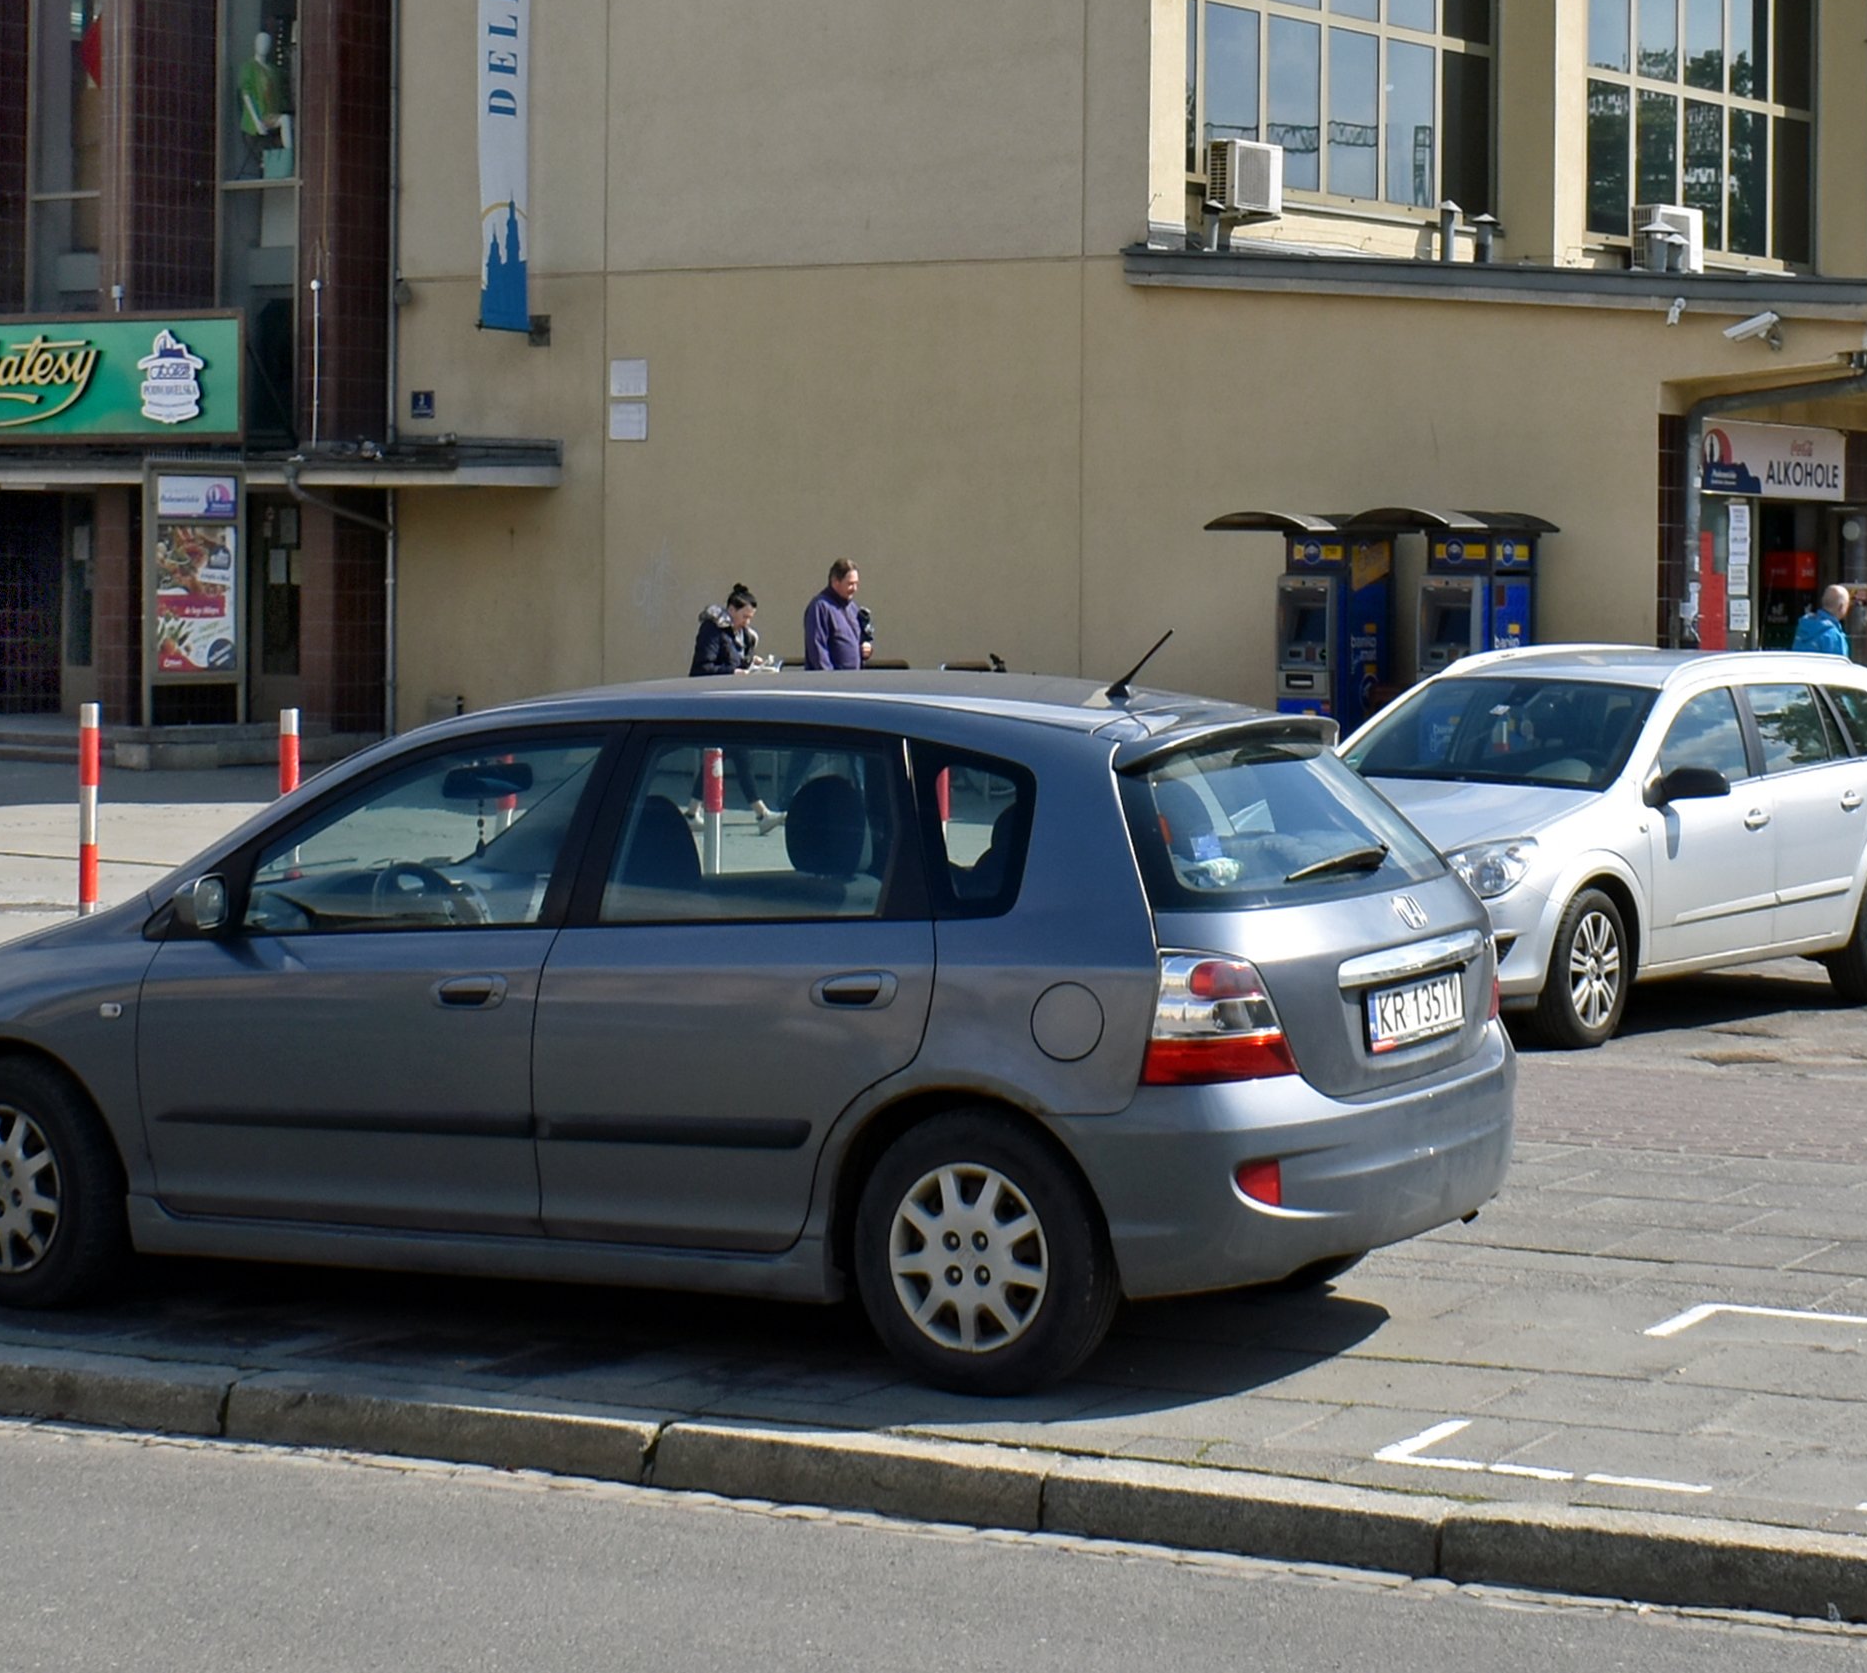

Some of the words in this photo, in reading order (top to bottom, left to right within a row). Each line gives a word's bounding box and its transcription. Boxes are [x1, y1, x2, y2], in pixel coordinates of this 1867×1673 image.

[1766, 460, 1839, 489] ALKOHOLE
[1377, 984, 1405, 1034] KR
[1412, 974, 1460, 1029] 135TV
